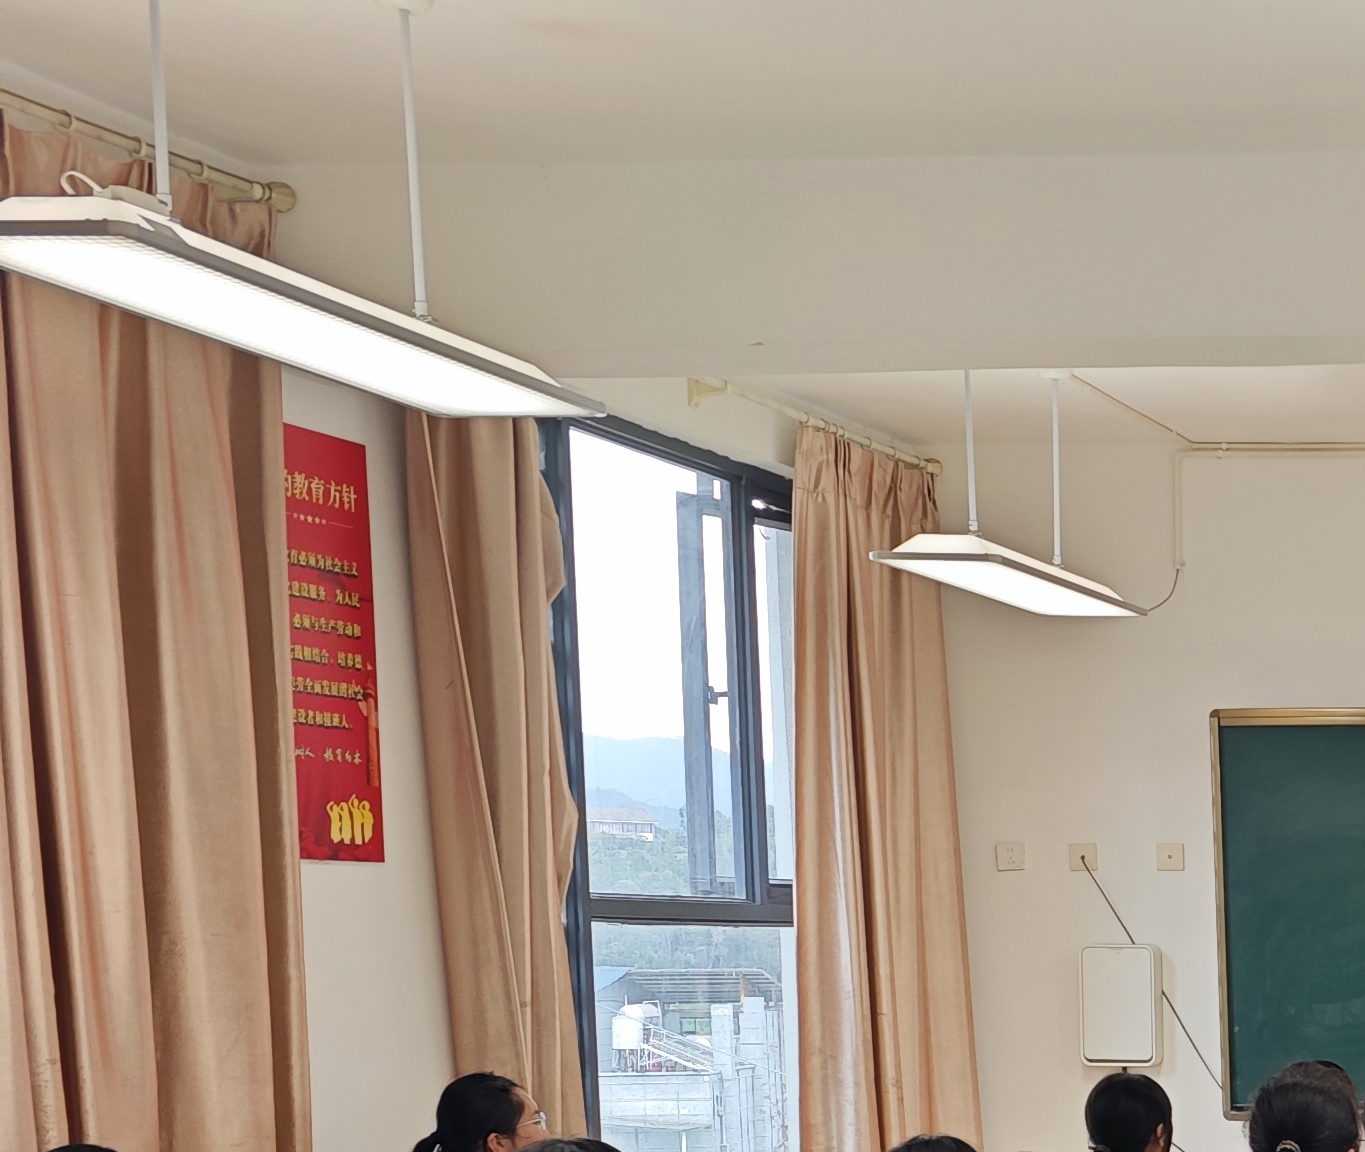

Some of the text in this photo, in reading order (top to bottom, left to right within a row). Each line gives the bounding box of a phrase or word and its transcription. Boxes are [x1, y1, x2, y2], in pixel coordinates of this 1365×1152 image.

[287, 549, 358, 576] 育必须为社会主义
